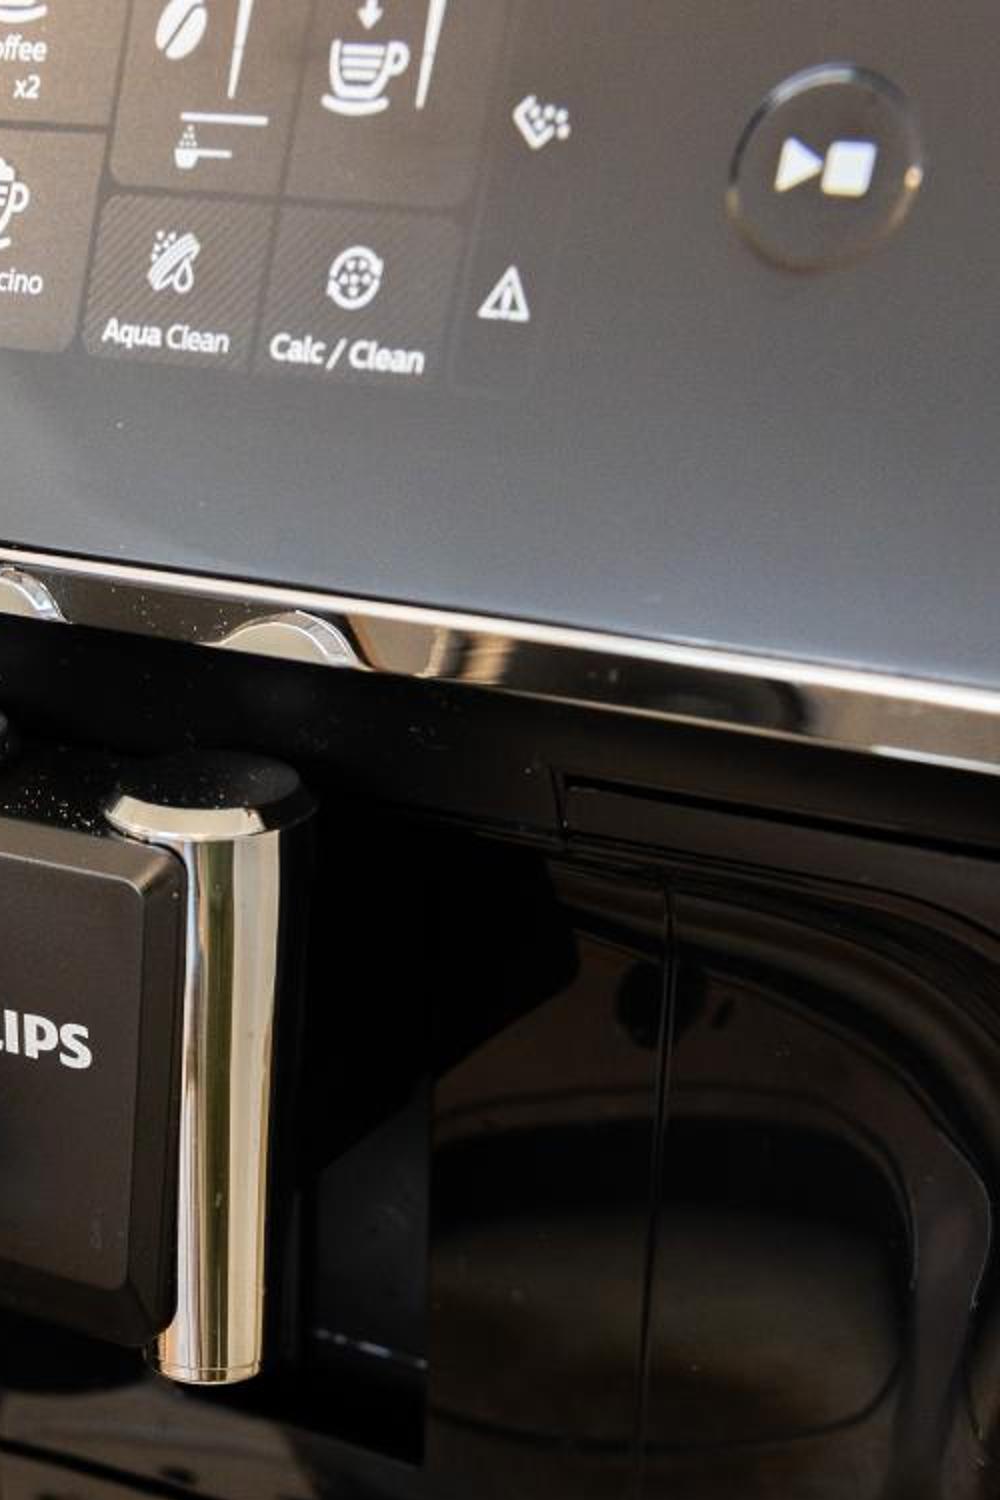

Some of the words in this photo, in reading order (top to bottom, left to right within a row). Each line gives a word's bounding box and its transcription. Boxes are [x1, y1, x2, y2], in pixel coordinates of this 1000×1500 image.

[13, 76, 40, 99] x2
[101, 317, 162, 348] Aqua
[166, 324, 230, 353] Clean
[269, 333, 324, 364] Calc
[326, 338, 347, 371] /
[349, 340, 425, 374] Clean
